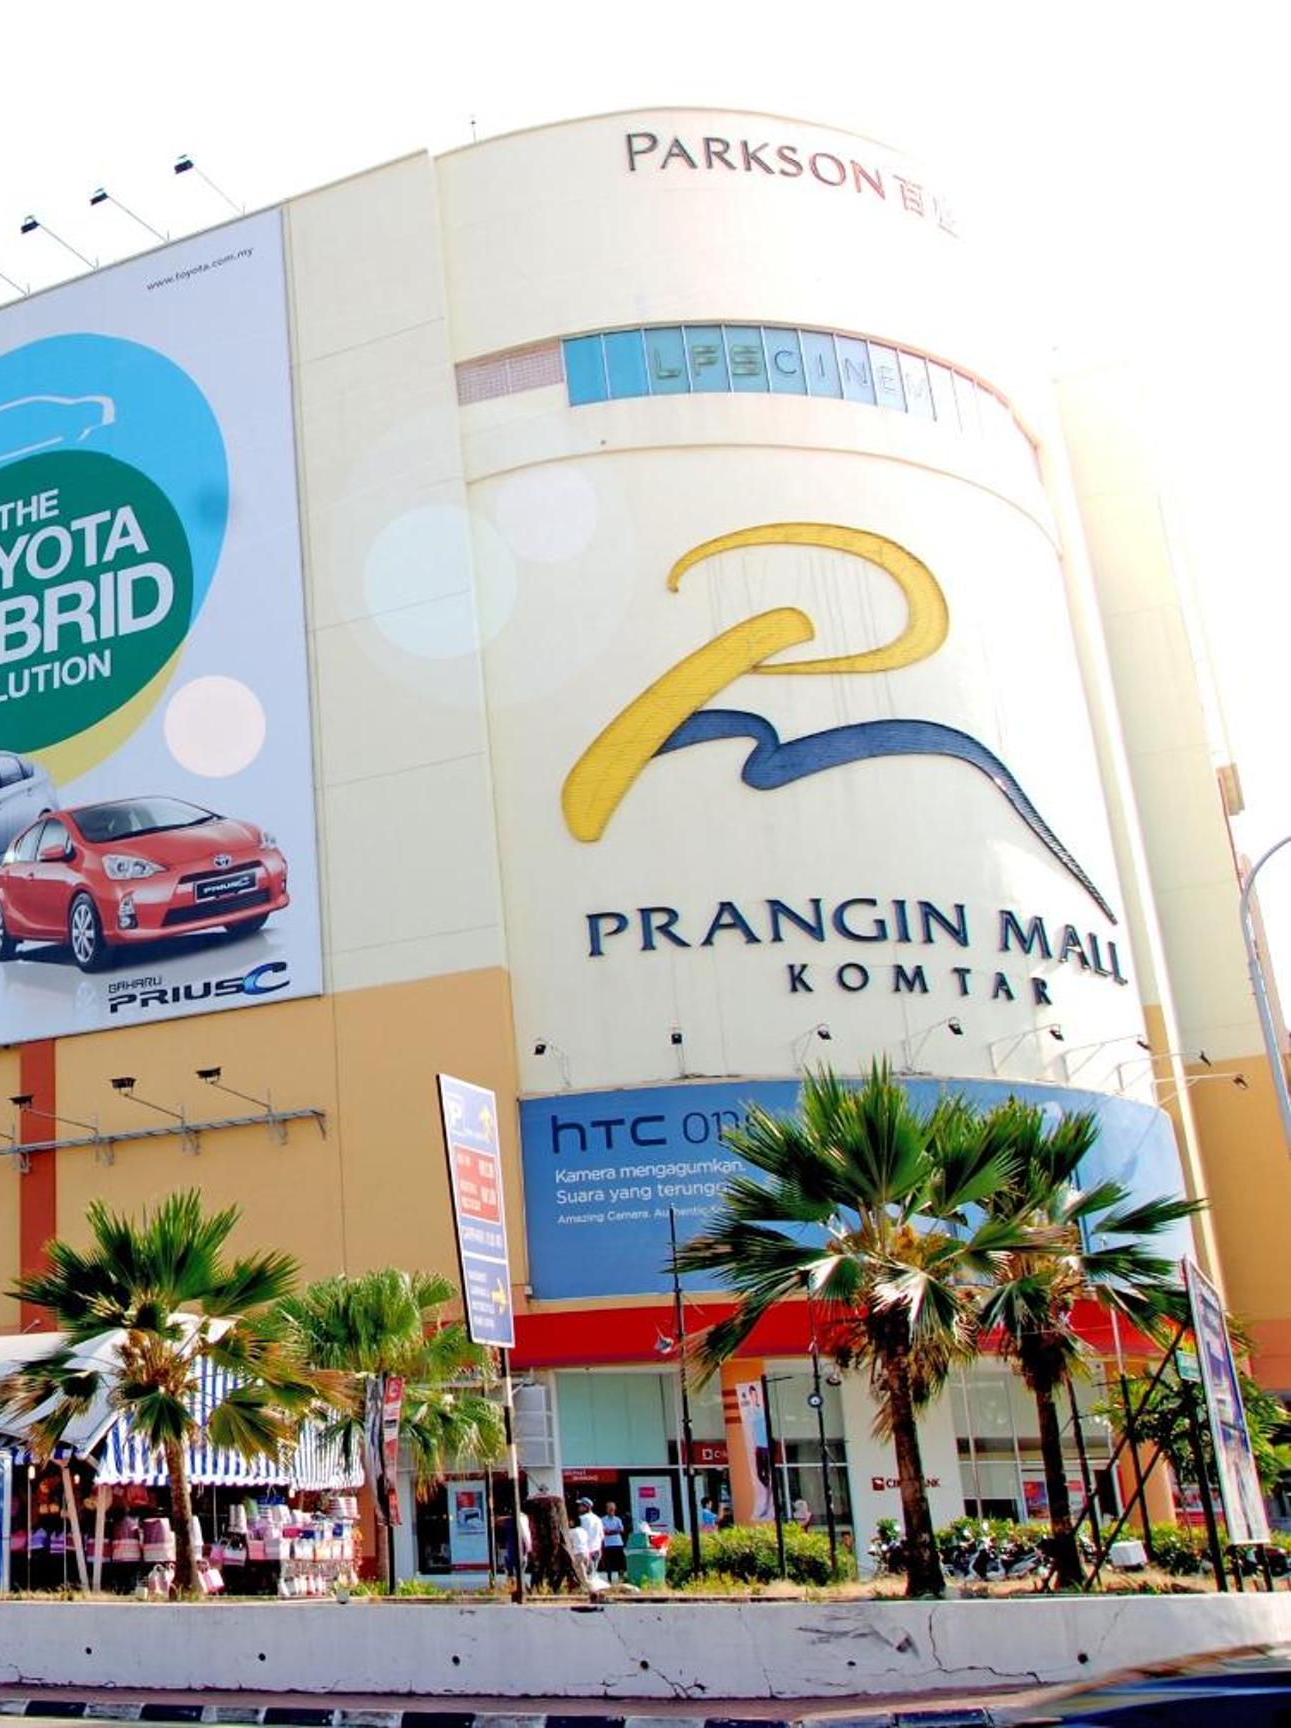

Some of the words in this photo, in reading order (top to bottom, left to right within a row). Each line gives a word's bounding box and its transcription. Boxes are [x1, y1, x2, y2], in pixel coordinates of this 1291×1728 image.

[625, 131, 886, 200] PARKSON
[146, 247, 255, 291] www.toyota.com.my
[585, 898, 970, 958] PRANGIN
[997, 908, 1129, 986] MALL
[108, 976, 163, 994] BAHARU
[787, 961, 1053, 1006] KOMTAR
[555, 1166, 616, 1184] Kamera
[619, 1158, 747, 1180] mengagumkan.
[556, 1188, 605, 1204] Suara
[610, 1186, 652, 1204] yang
[557, 1212, 605, 1225] Amazing
